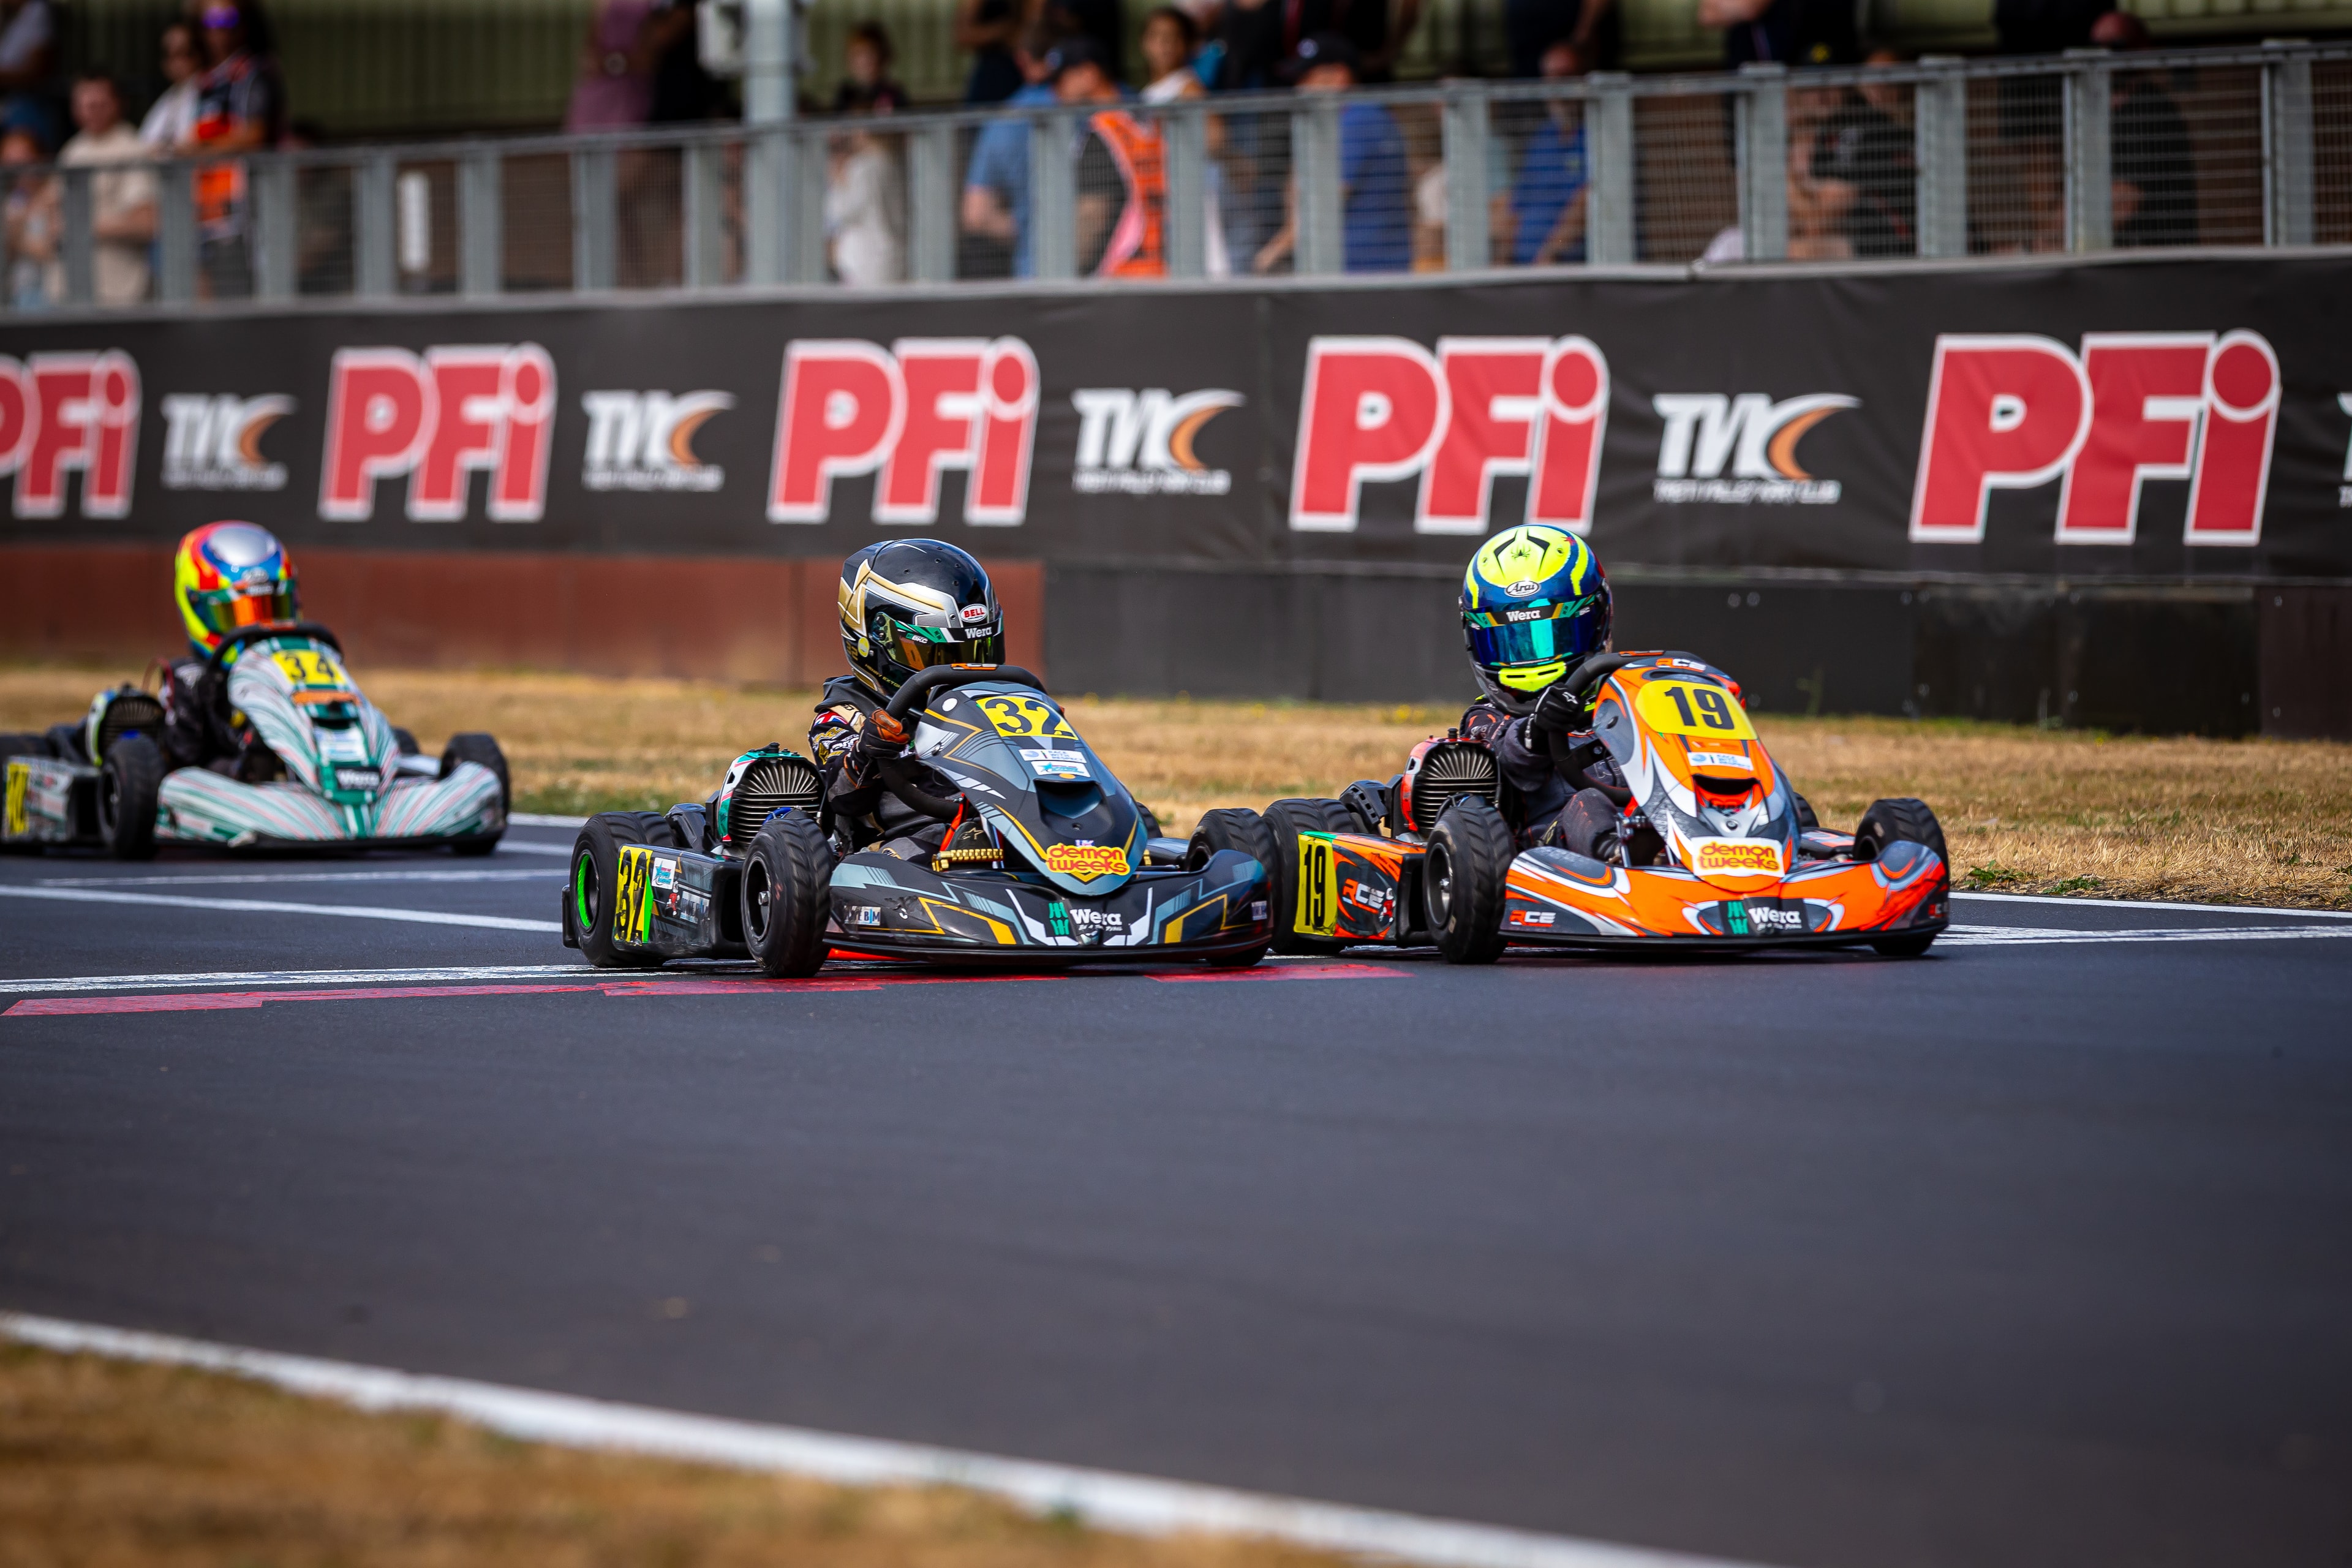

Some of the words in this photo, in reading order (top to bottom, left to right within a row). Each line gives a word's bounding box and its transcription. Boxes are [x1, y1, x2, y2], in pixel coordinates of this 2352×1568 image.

[317, 342, 557, 522] PFi
[766, 336, 1040, 526] PFi
[1289, 334, 1611, 535] PFi
[1909, 328, 2282, 546] PFi
[1509, 582, 1535, 594] Arai
[963, 608, 986, 618] BELL
[1506, 609, 1541, 622] Wera
[965, 627, 992, 639] Wera
[284, 654, 334, 680] 34
[1656, 657, 1706, 672] RCE
[1664, 687, 1735, 729] 19
[984, 698, 1075, 737] 32
[1049, 845, 1123, 861] demon
[1702, 843, 1776, 858] demon
[1047, 858, 1128, 873] tweeks
[1699, 856, 1779, 870] tweeks
[1304, 845, 1326, 928] 19
[1343, 878, 1385, 911] RCE
[614, 849, 647, 943] 32
[1069, 908, 1122, 925] Wera
[1510, 910, 1556, 925] RCE
[1748, 907, 1801, 924] Wera
